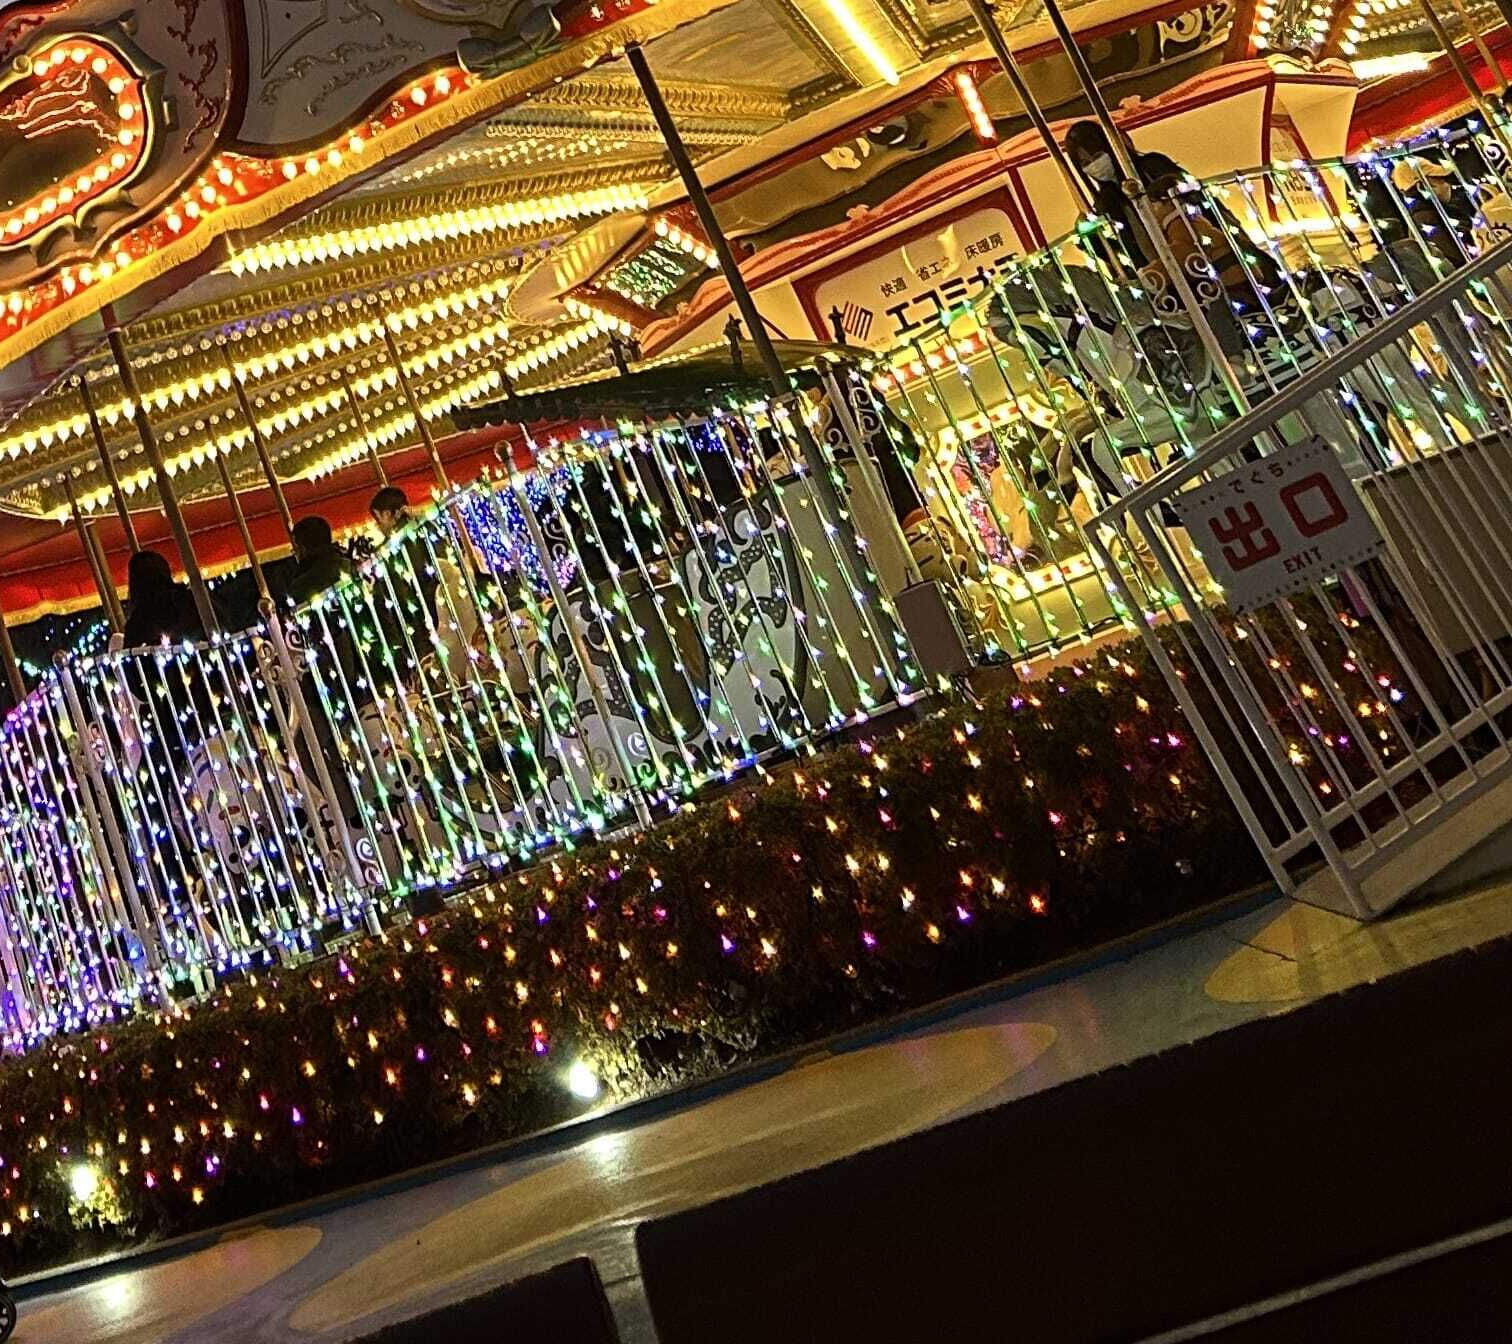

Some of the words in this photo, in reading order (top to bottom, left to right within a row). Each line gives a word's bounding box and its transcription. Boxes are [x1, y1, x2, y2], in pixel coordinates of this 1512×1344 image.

[880, 277, 907, 297] 快適
[964, 232, 1004, 260] 床暖房
[1208, 471, 1349, 572] 出口
[1283, 546, 1323, 573] EXIT
